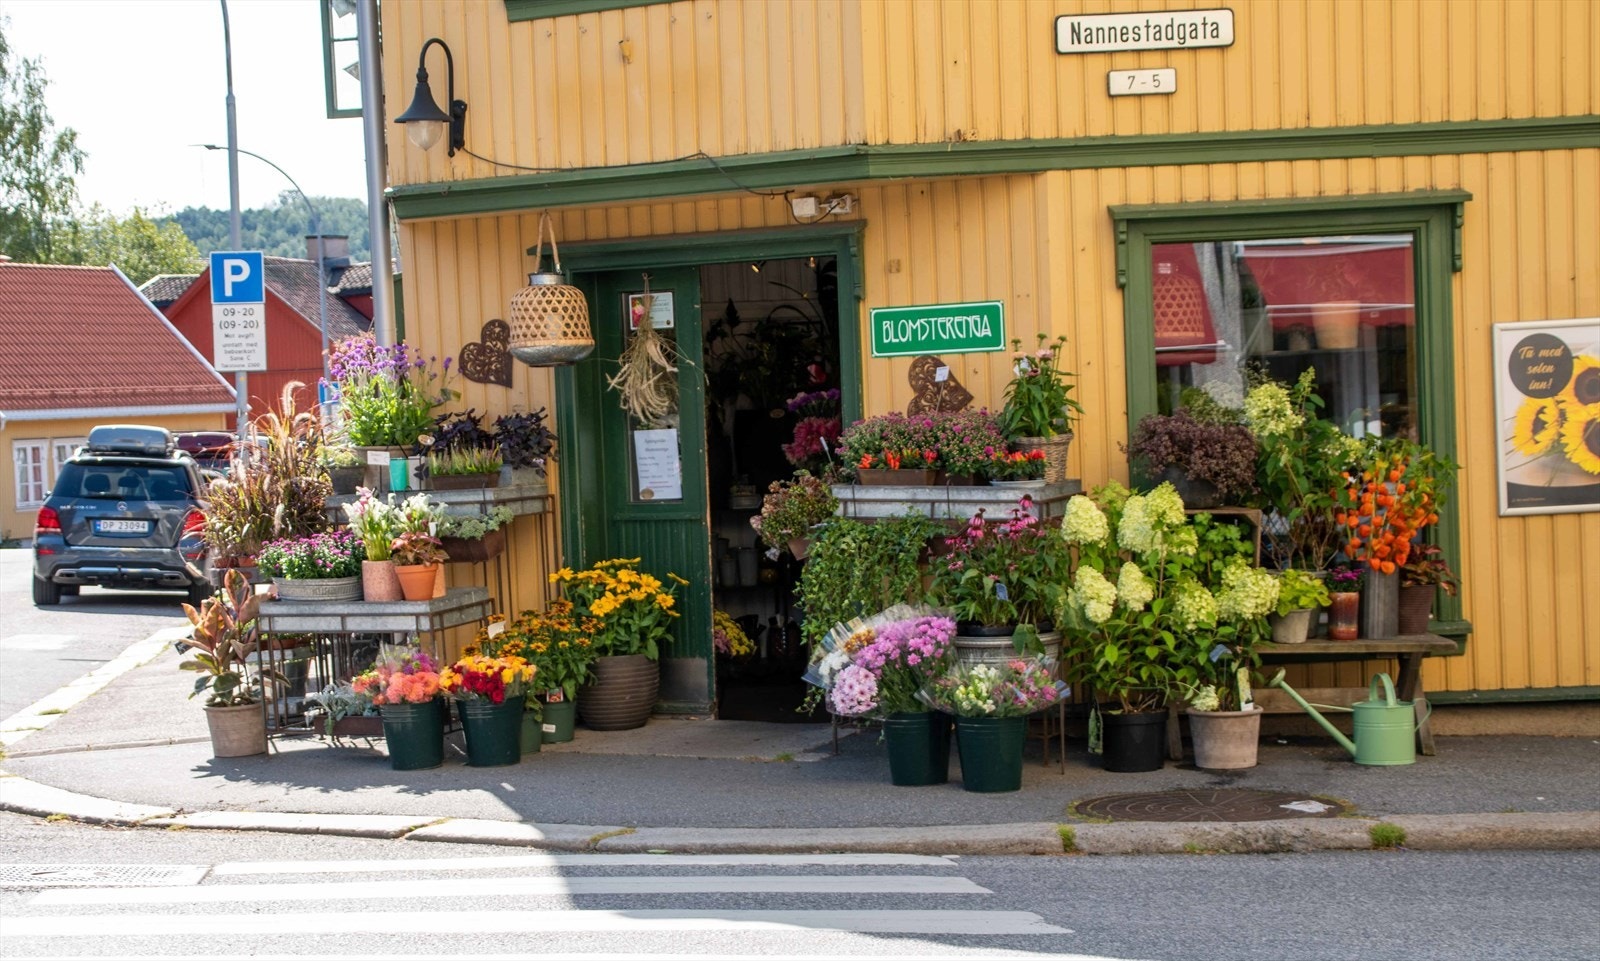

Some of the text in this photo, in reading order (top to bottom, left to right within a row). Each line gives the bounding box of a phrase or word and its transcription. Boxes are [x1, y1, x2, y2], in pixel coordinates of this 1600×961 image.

[1070, 16, 1220, 45] Nannestadgata
[223, 258, 251, 297] P
[882, 314, 993, 344] BLOMSTERENGA
[1519, 345, 1565, 360] Ta med
[1526, 362, 1555, 375] solen
[1528, 377, 1553, 391] inn!
[102, 520, 146, 531] DP 23094
